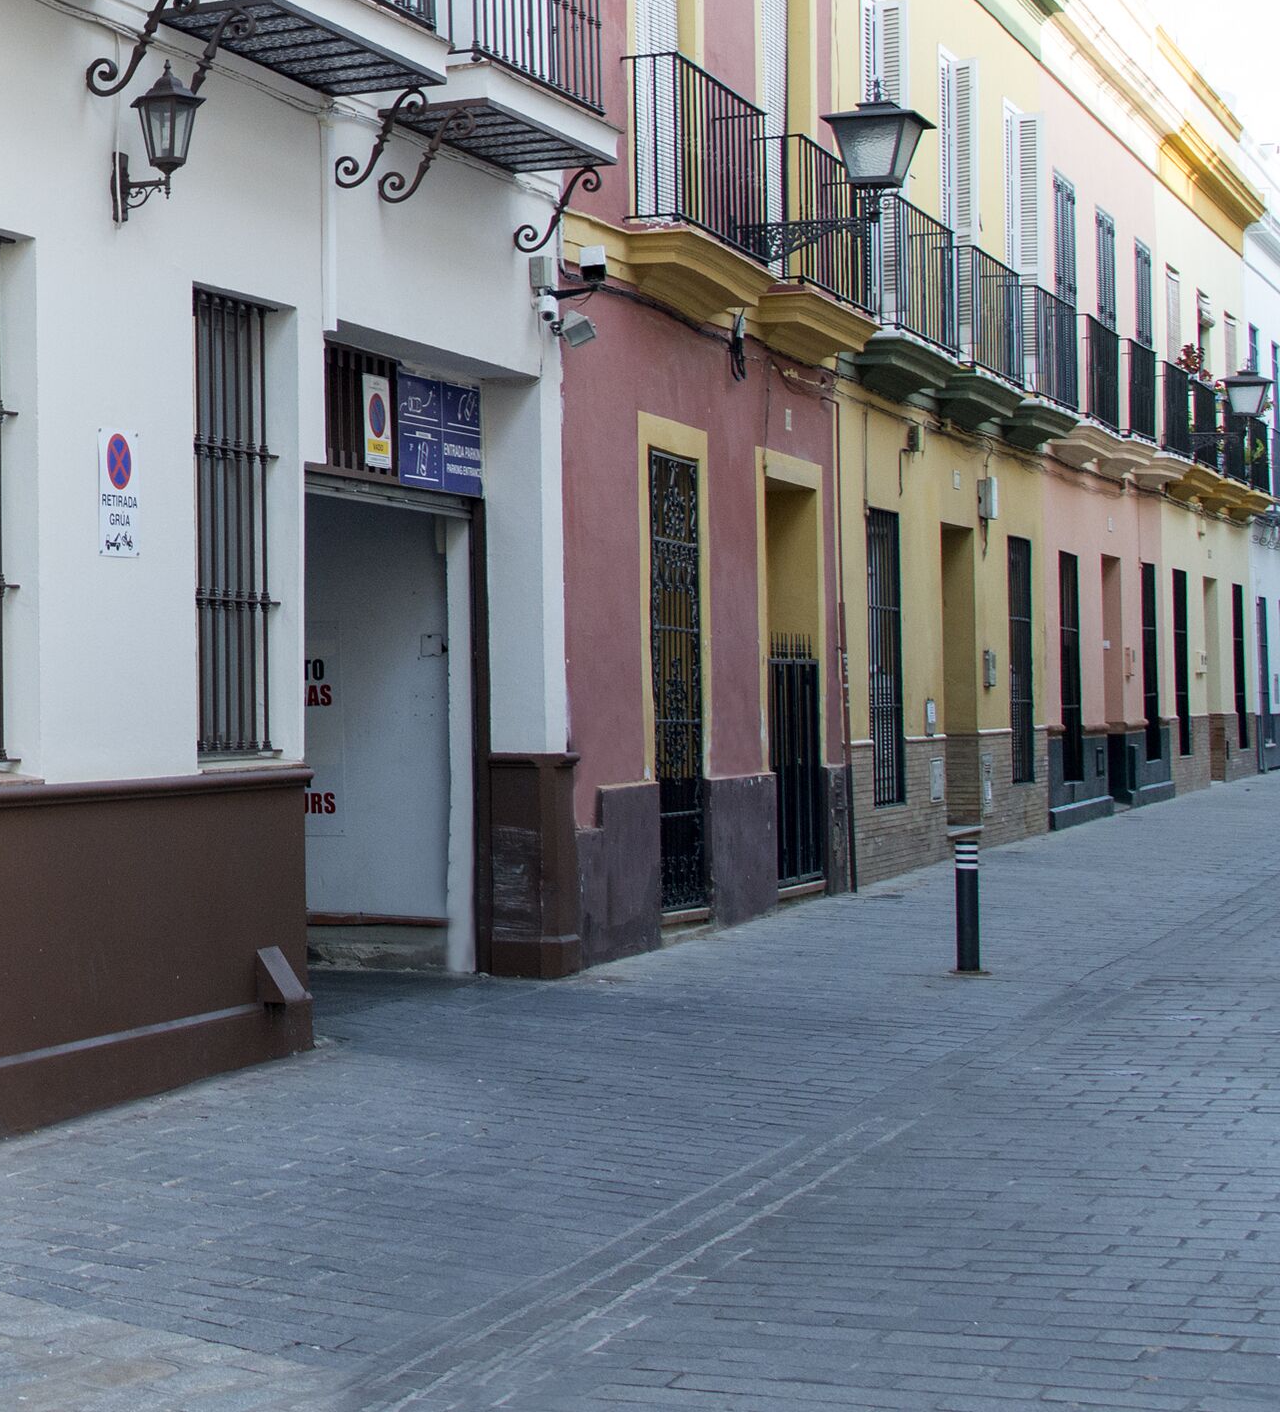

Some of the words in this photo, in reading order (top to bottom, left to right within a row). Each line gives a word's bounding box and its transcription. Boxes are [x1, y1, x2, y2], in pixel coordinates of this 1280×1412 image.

[444, 442, 465, 458] ENTRADA
[446, 463, 463, 475] PARKING
[102, 493, 138, 509] RETIRADA
[109, 511, 130, 526] GRÚA
